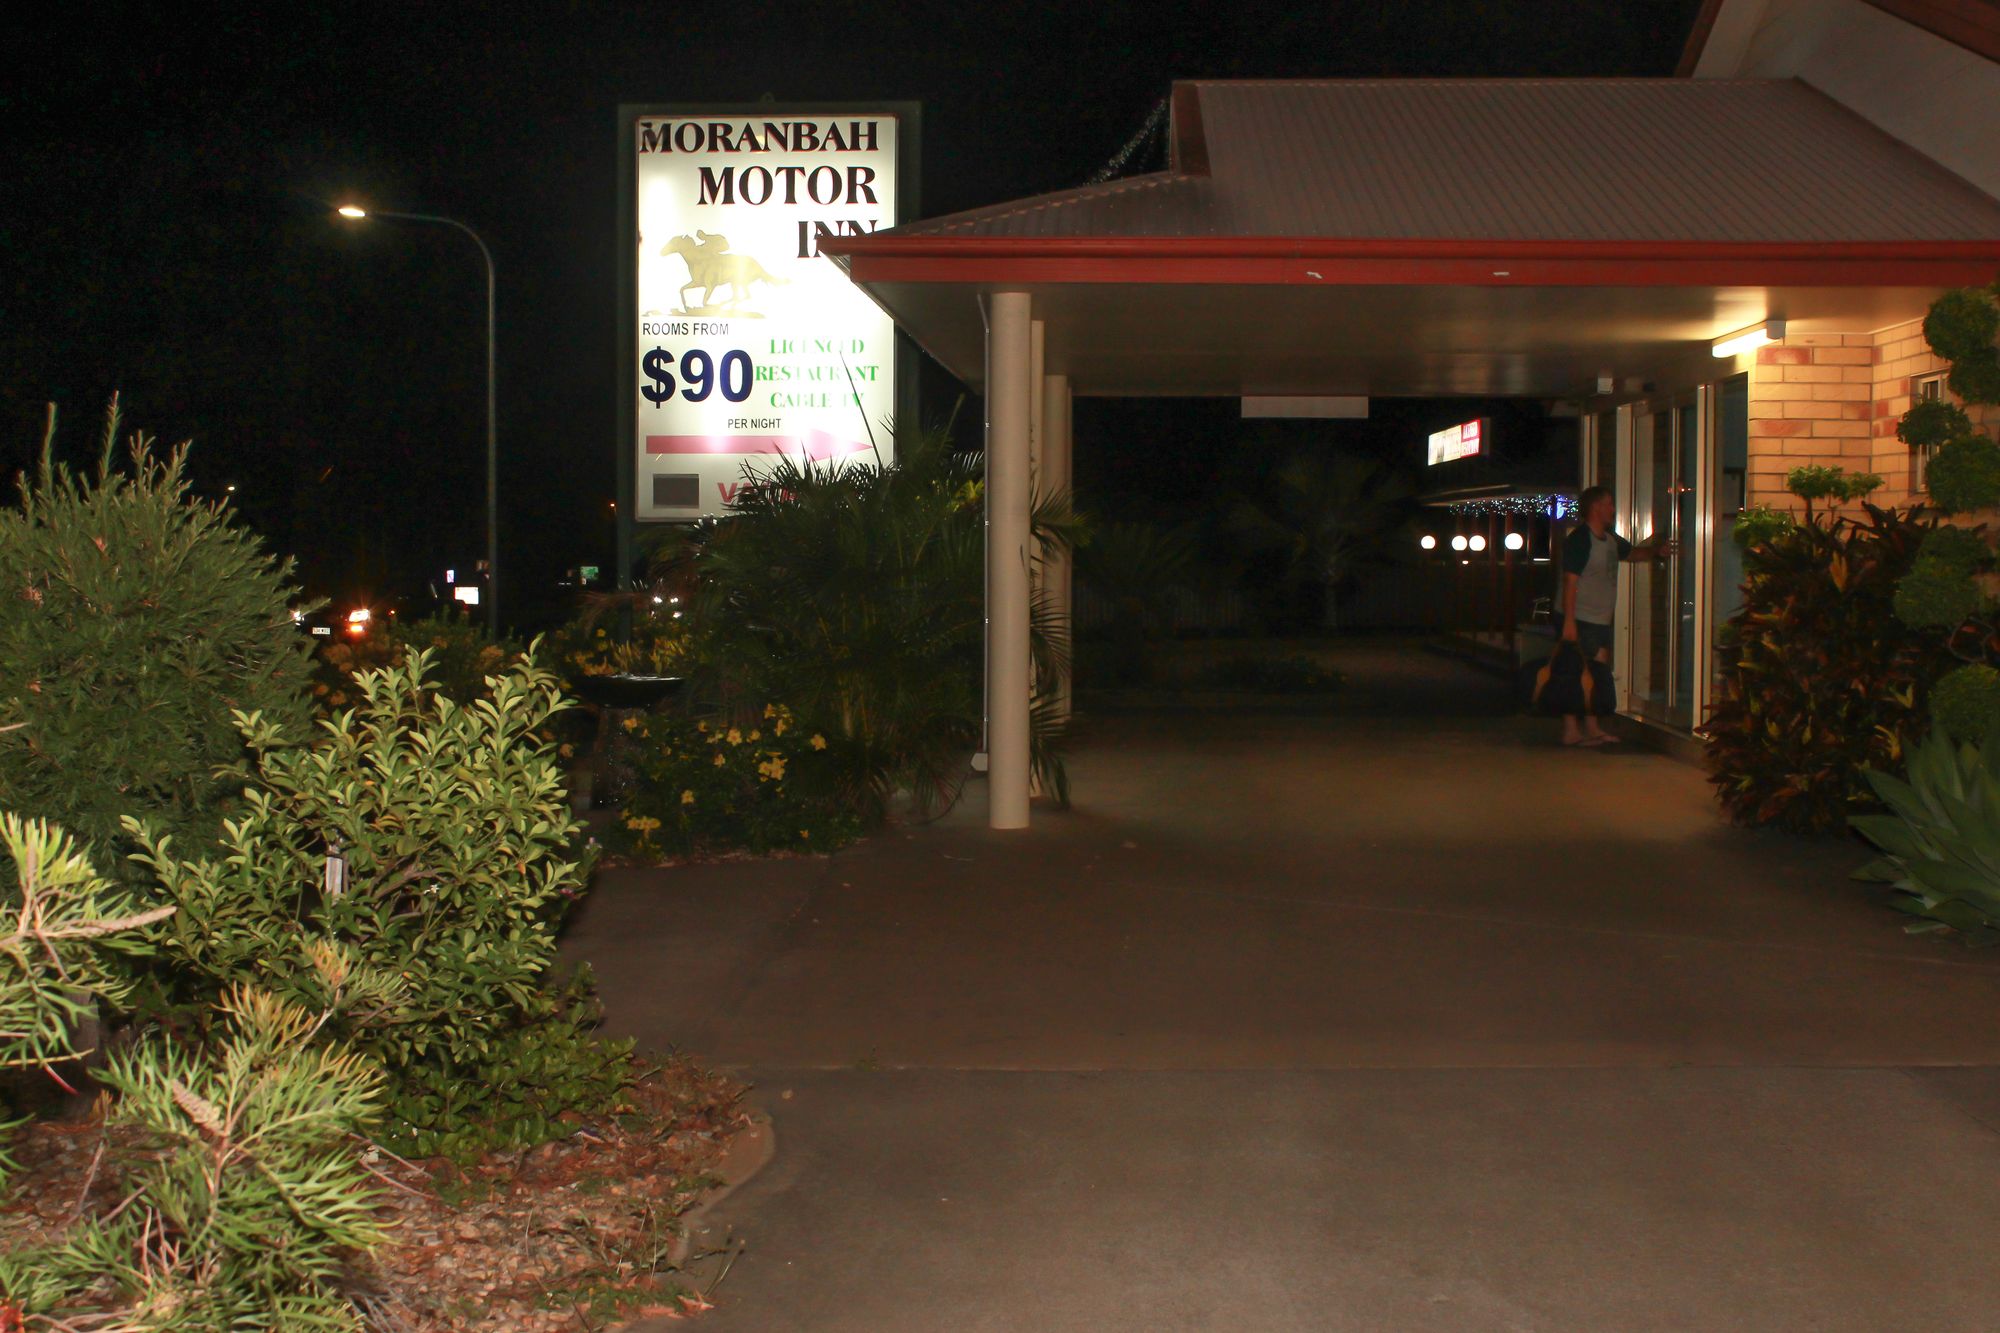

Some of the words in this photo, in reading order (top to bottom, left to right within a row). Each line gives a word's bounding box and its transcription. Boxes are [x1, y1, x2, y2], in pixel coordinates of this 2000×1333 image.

[639, 121, 879, 153] MORANBAH
[696, 165, 878, 206] MOTOR
[642, 322, 689, 336] ROOMS
[693, 322, 729, 336] FROM
[769, 338, 865, 354] LICNCD
[640, 345, 754, 409] $90
[755, 365, 879, 381] RESTAURNT
[727, 418, 747, 429] PER
[750, 418, 781, 429] NIGHT
